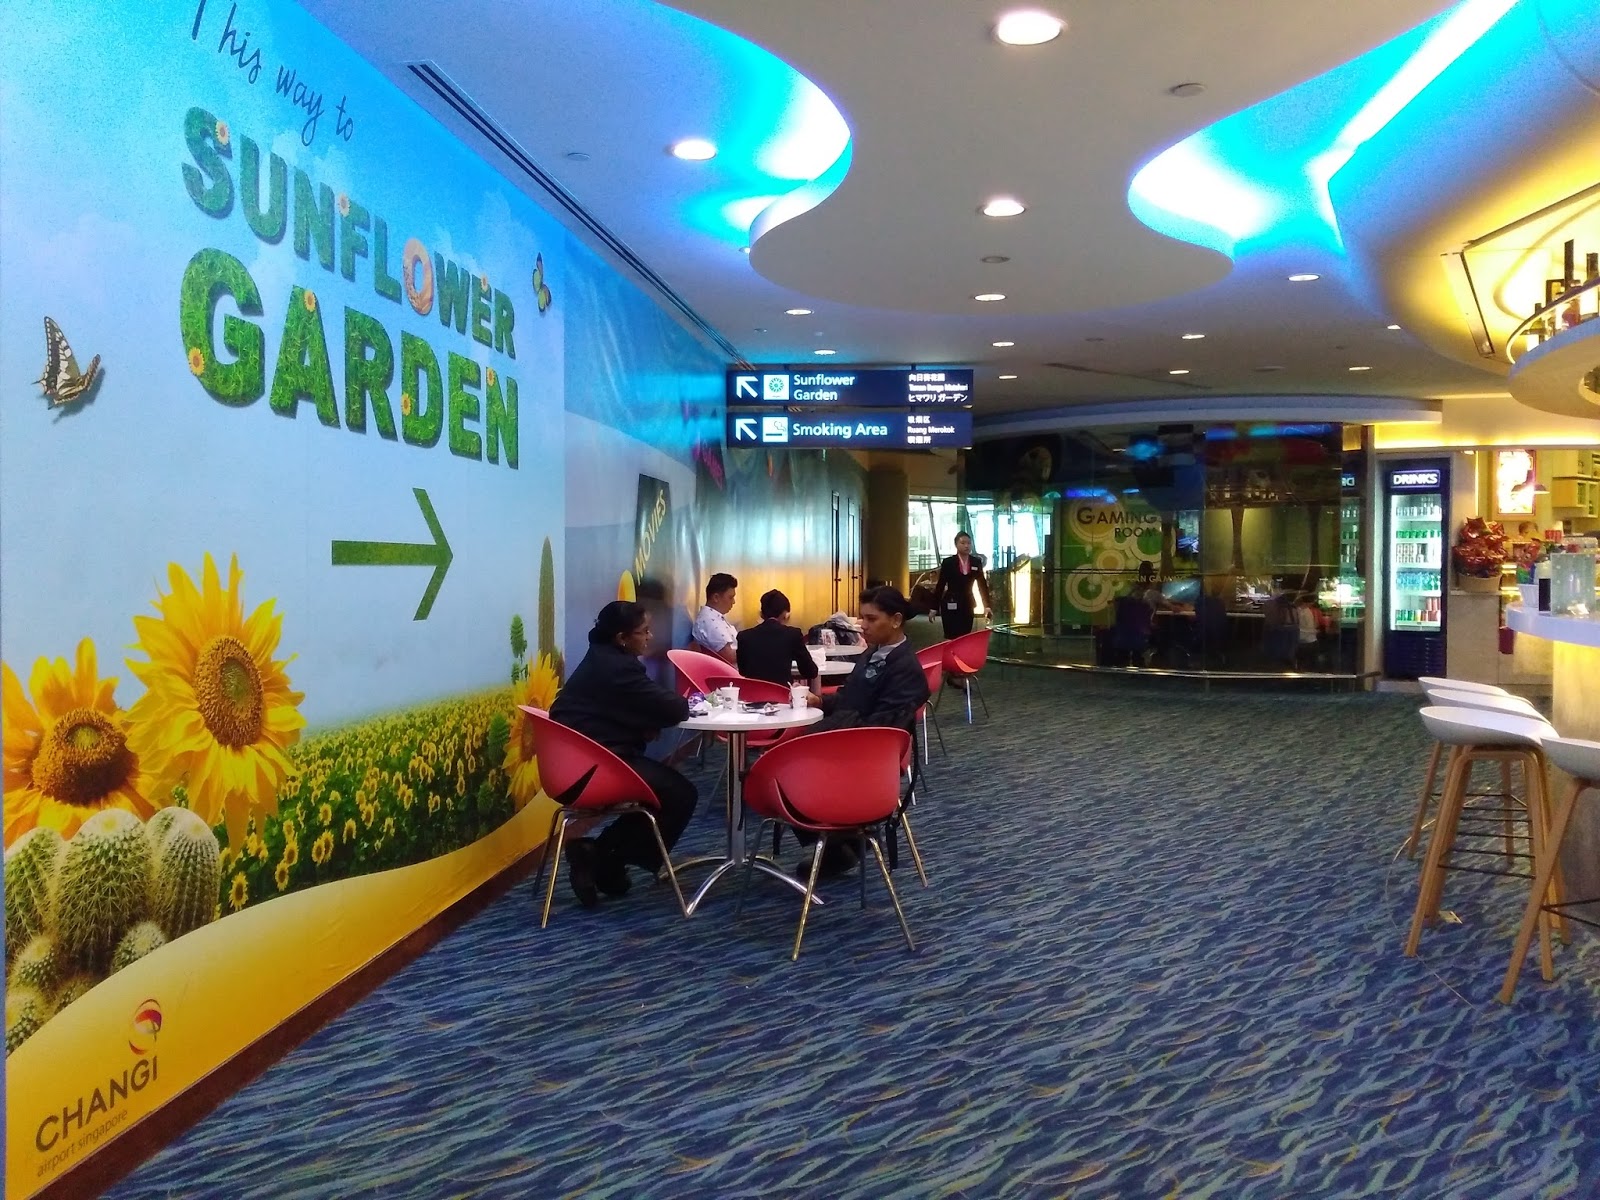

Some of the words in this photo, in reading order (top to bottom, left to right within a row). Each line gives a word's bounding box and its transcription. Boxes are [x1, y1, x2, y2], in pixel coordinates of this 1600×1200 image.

[276, 65, 325, 146] way
[336, 95, 354, 142] to
[181, 106, 517, 360] SUNFLOWER
[180, 247, 520, 470] GARDEN
[793, 374, 856, 386] Sunflower
[793, 389, 838, 401] Garden
[792, 422, 851, 439] Smoking
[855, 424, 888, 436] Area
[1392, 473, 1438, 485] DRINKS
[634, 488, 667, 587] MOVIES
[1076, 506, 1159, 525] GAMING
[35, 1055, 158, 1153] CHANGI
[37, 1143, 76, 1178] airport
[78, 1109, 128, 1150] singapore
